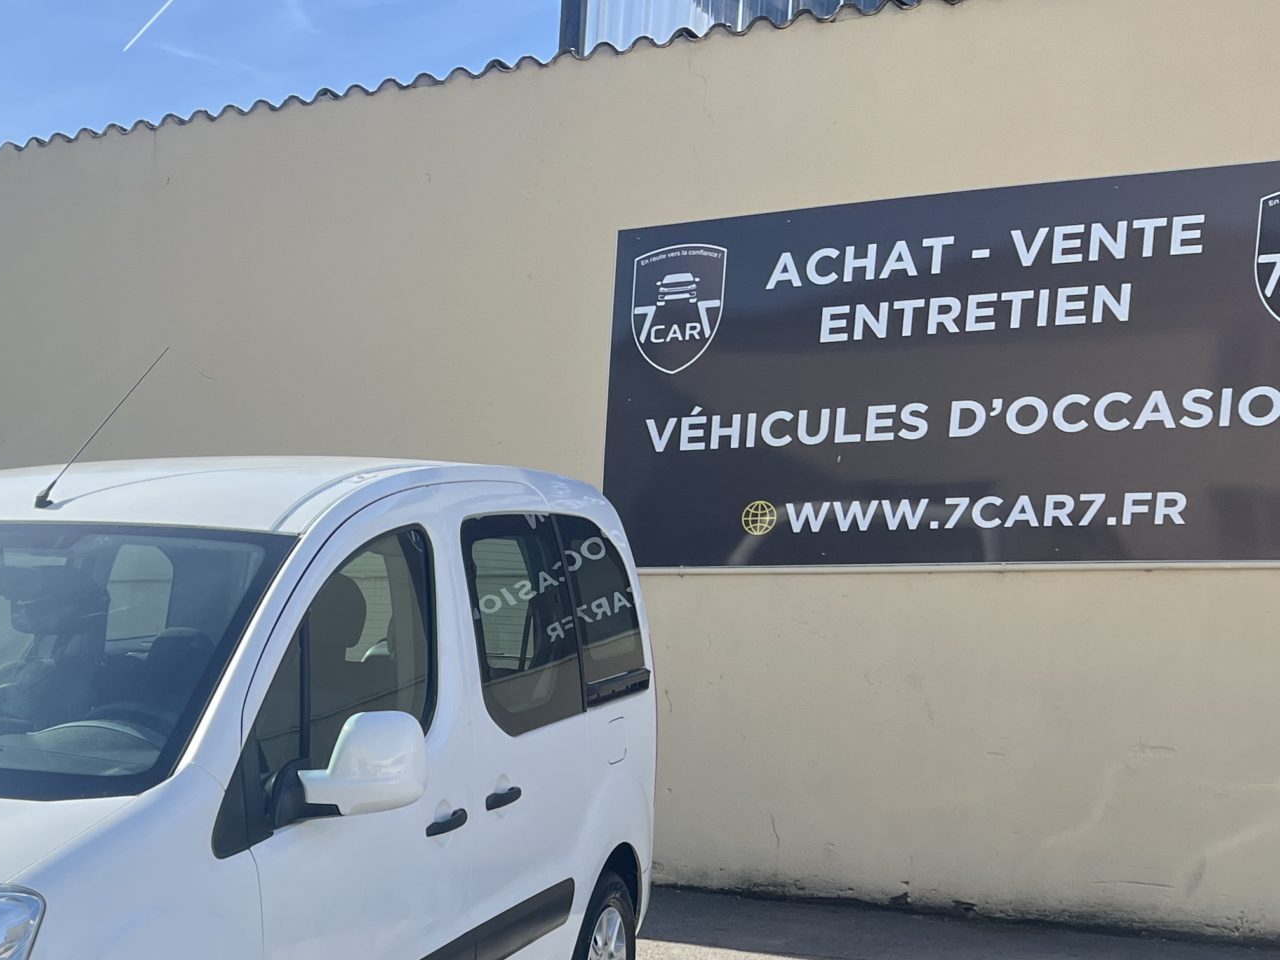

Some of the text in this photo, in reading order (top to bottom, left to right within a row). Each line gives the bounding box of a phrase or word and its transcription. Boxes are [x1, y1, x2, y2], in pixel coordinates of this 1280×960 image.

[649, 253, 666, 262] route
[667, 250, 681, 258] vers
[688, 249, 718, 258] confiance
[766, 235, 955, 290] ACHAT
[1011, 214, 1206, 267] VENTE
[819, 283, 1132, 343] ENTRETIEN
[646, 402, 928, 453] VÉHICULES
[785, 491, 1187, 534] WWW.7CAR7.FR
